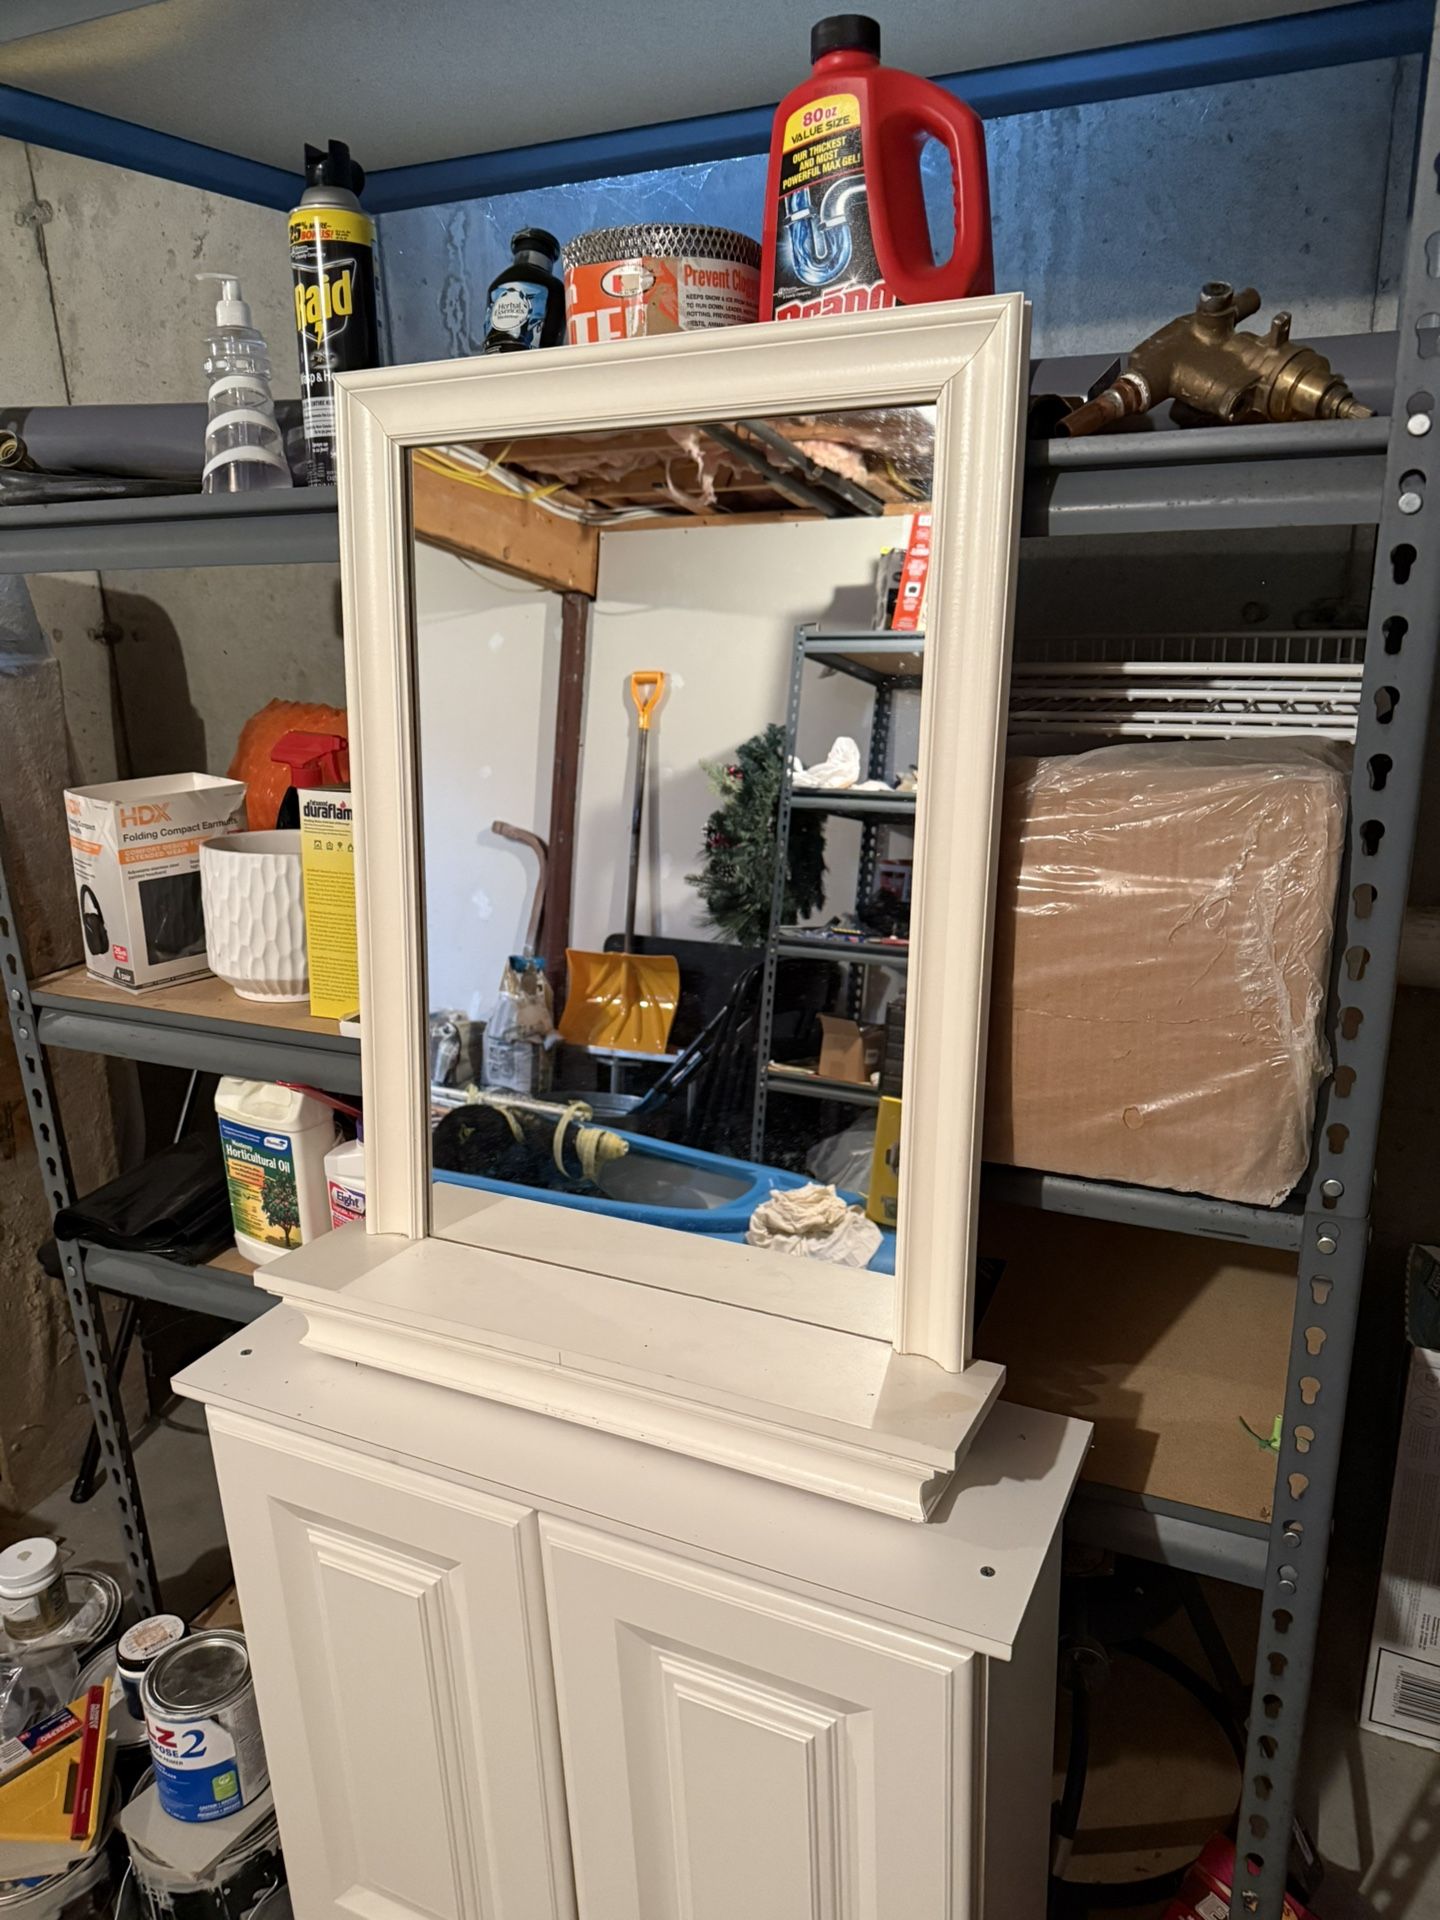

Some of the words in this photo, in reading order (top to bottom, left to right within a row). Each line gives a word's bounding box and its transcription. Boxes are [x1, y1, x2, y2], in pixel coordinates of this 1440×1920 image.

[791, 124, 823, 144] VALUE
[825, 115, 850, 131] SIZE
[803, 108, 823, 127] 80
[793, 149, 808, 164] OUR
[809, 136, 846, 157] THICKEST
[799, 158, 815, 171] AND
[816, 149, 838, 165] MOST
[783, 166, 820, 190] POWERFUL
[822, 159, 841, 174] MAX
[842, 152, 861, 167] GEL!
[684, 264, 730, 289] Prevent
[294, 269, 353, 331] Raid
[705, 294, 720, 302] SNOW
[120, 802, 172, 828] HDX
[123, 831, 158, 843] Folding
[160, 824, 200, 837] Compact
[226, 1144, 277, 1169] Horticultural
[278, 1160, 291, 1174] Oil
[336, 1190, 360, 1208] Eight
[180, 1729, 207, 1758] 2
